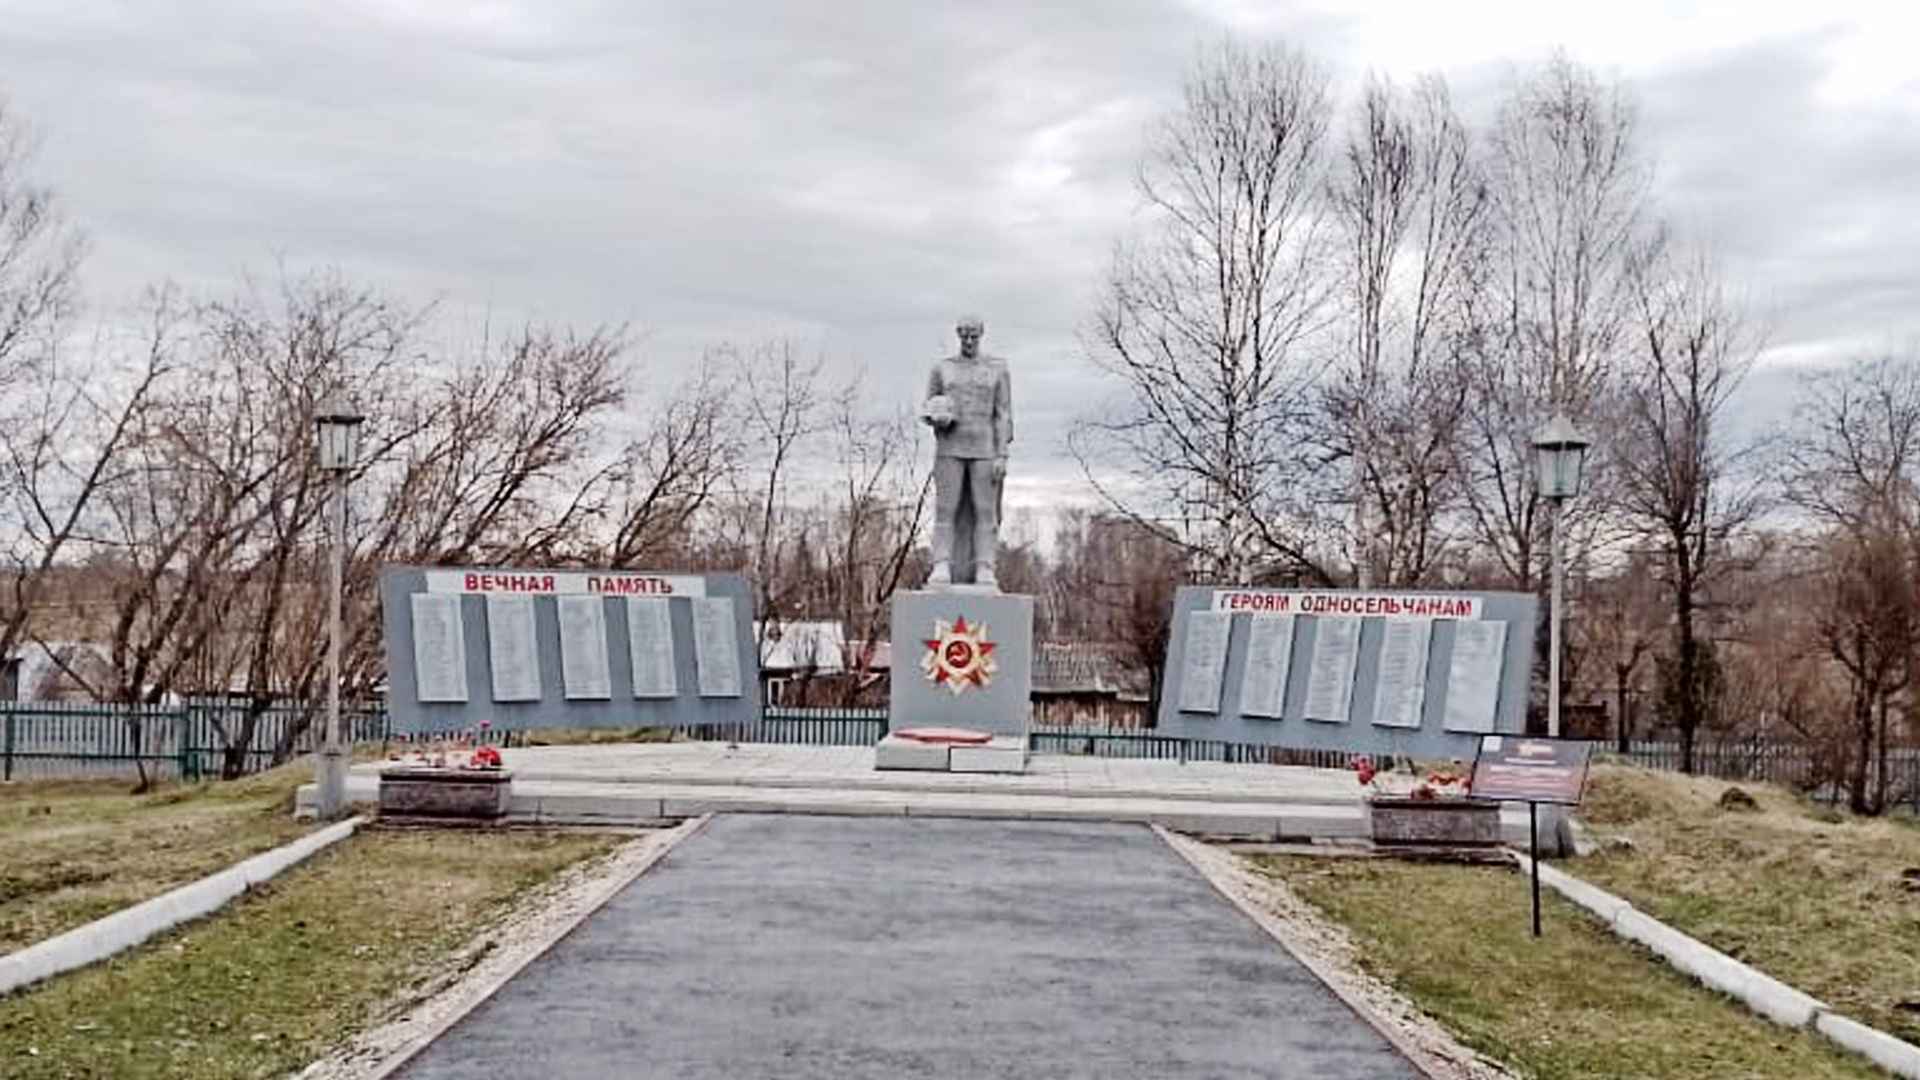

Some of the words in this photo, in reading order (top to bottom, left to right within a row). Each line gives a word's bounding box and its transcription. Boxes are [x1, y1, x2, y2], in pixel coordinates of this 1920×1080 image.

[464, 573, 555, 592] ВЕЧНАЯ
[587, 576, 673, 594] ПАМЯТЬ
[1220, 594, 1290, 611] ГЕРОЯМ
[1301, 596, 1472, 616] ОДНОСЕЛЬЧАНАМ
